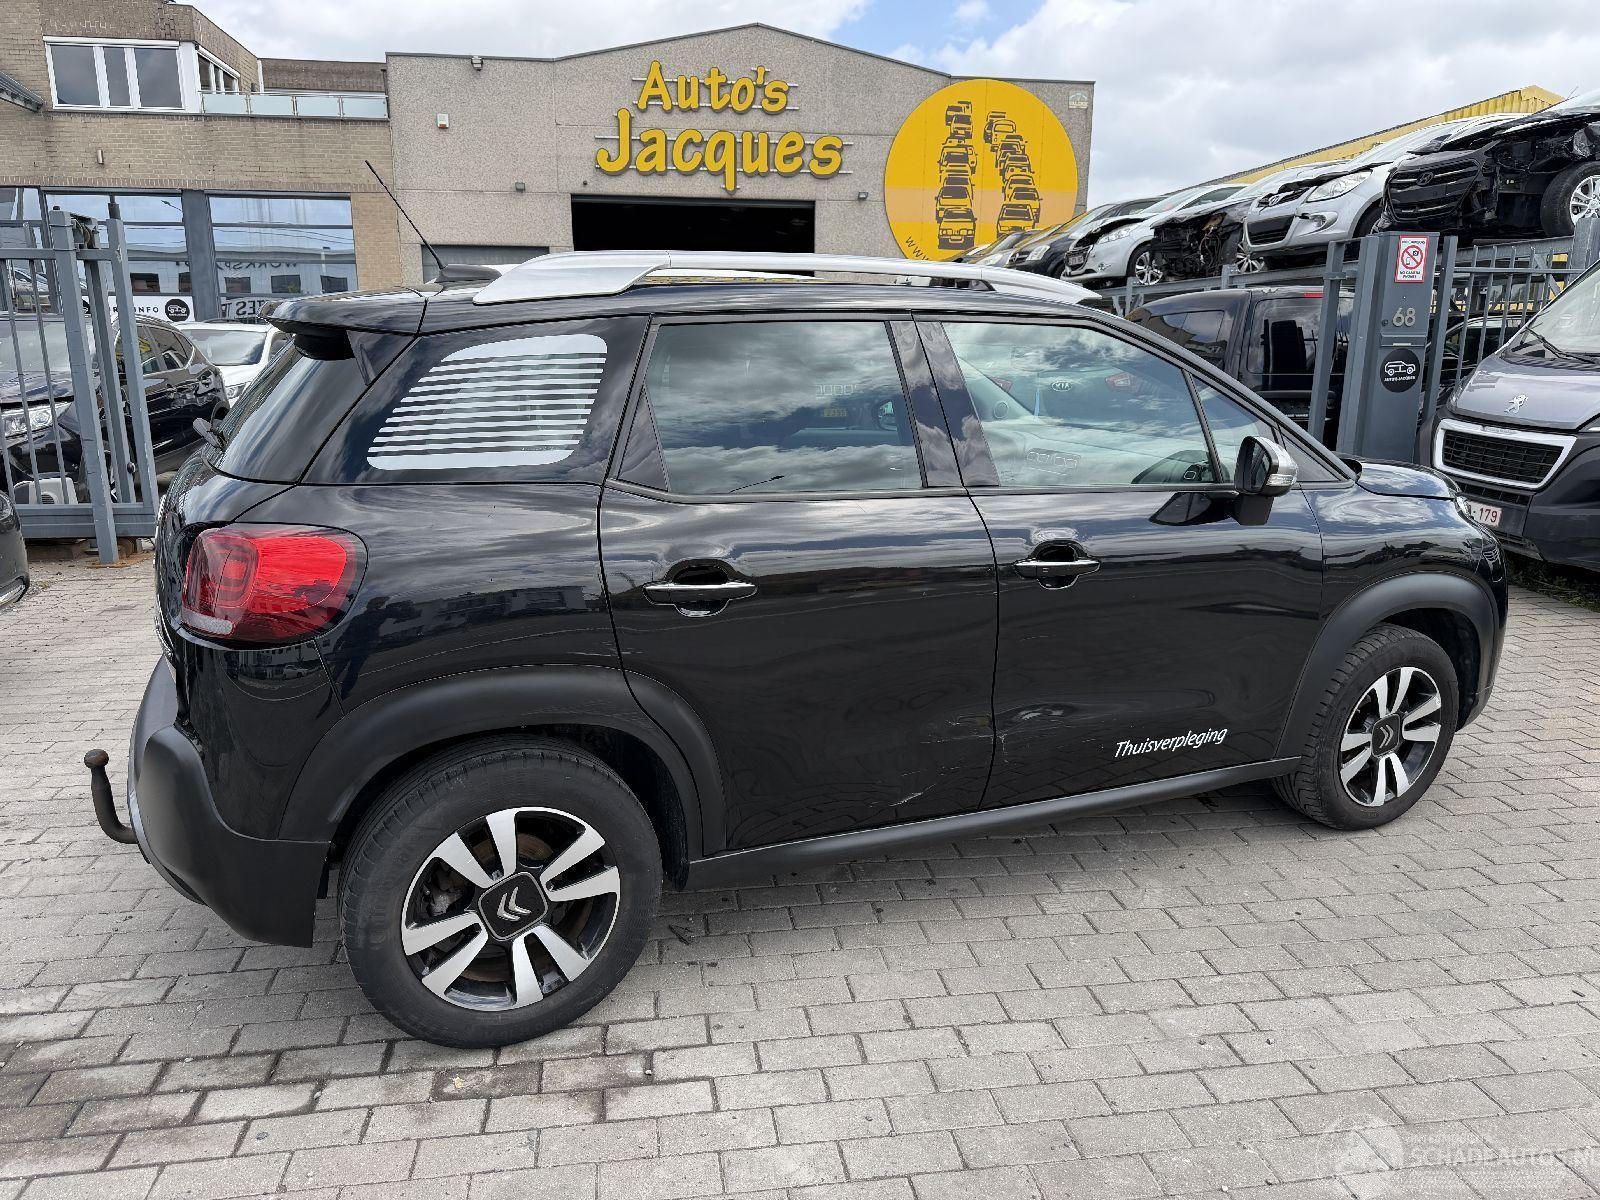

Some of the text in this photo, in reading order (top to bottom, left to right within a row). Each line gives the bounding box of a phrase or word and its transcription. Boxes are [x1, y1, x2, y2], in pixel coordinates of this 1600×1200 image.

[637, 60, 789, 113] Auto's
[597, 108, 844, 193] Jacques
[1393, 307, 1416, 327] 68
[1114, 728, 1228, 758] Thuisverpleging
